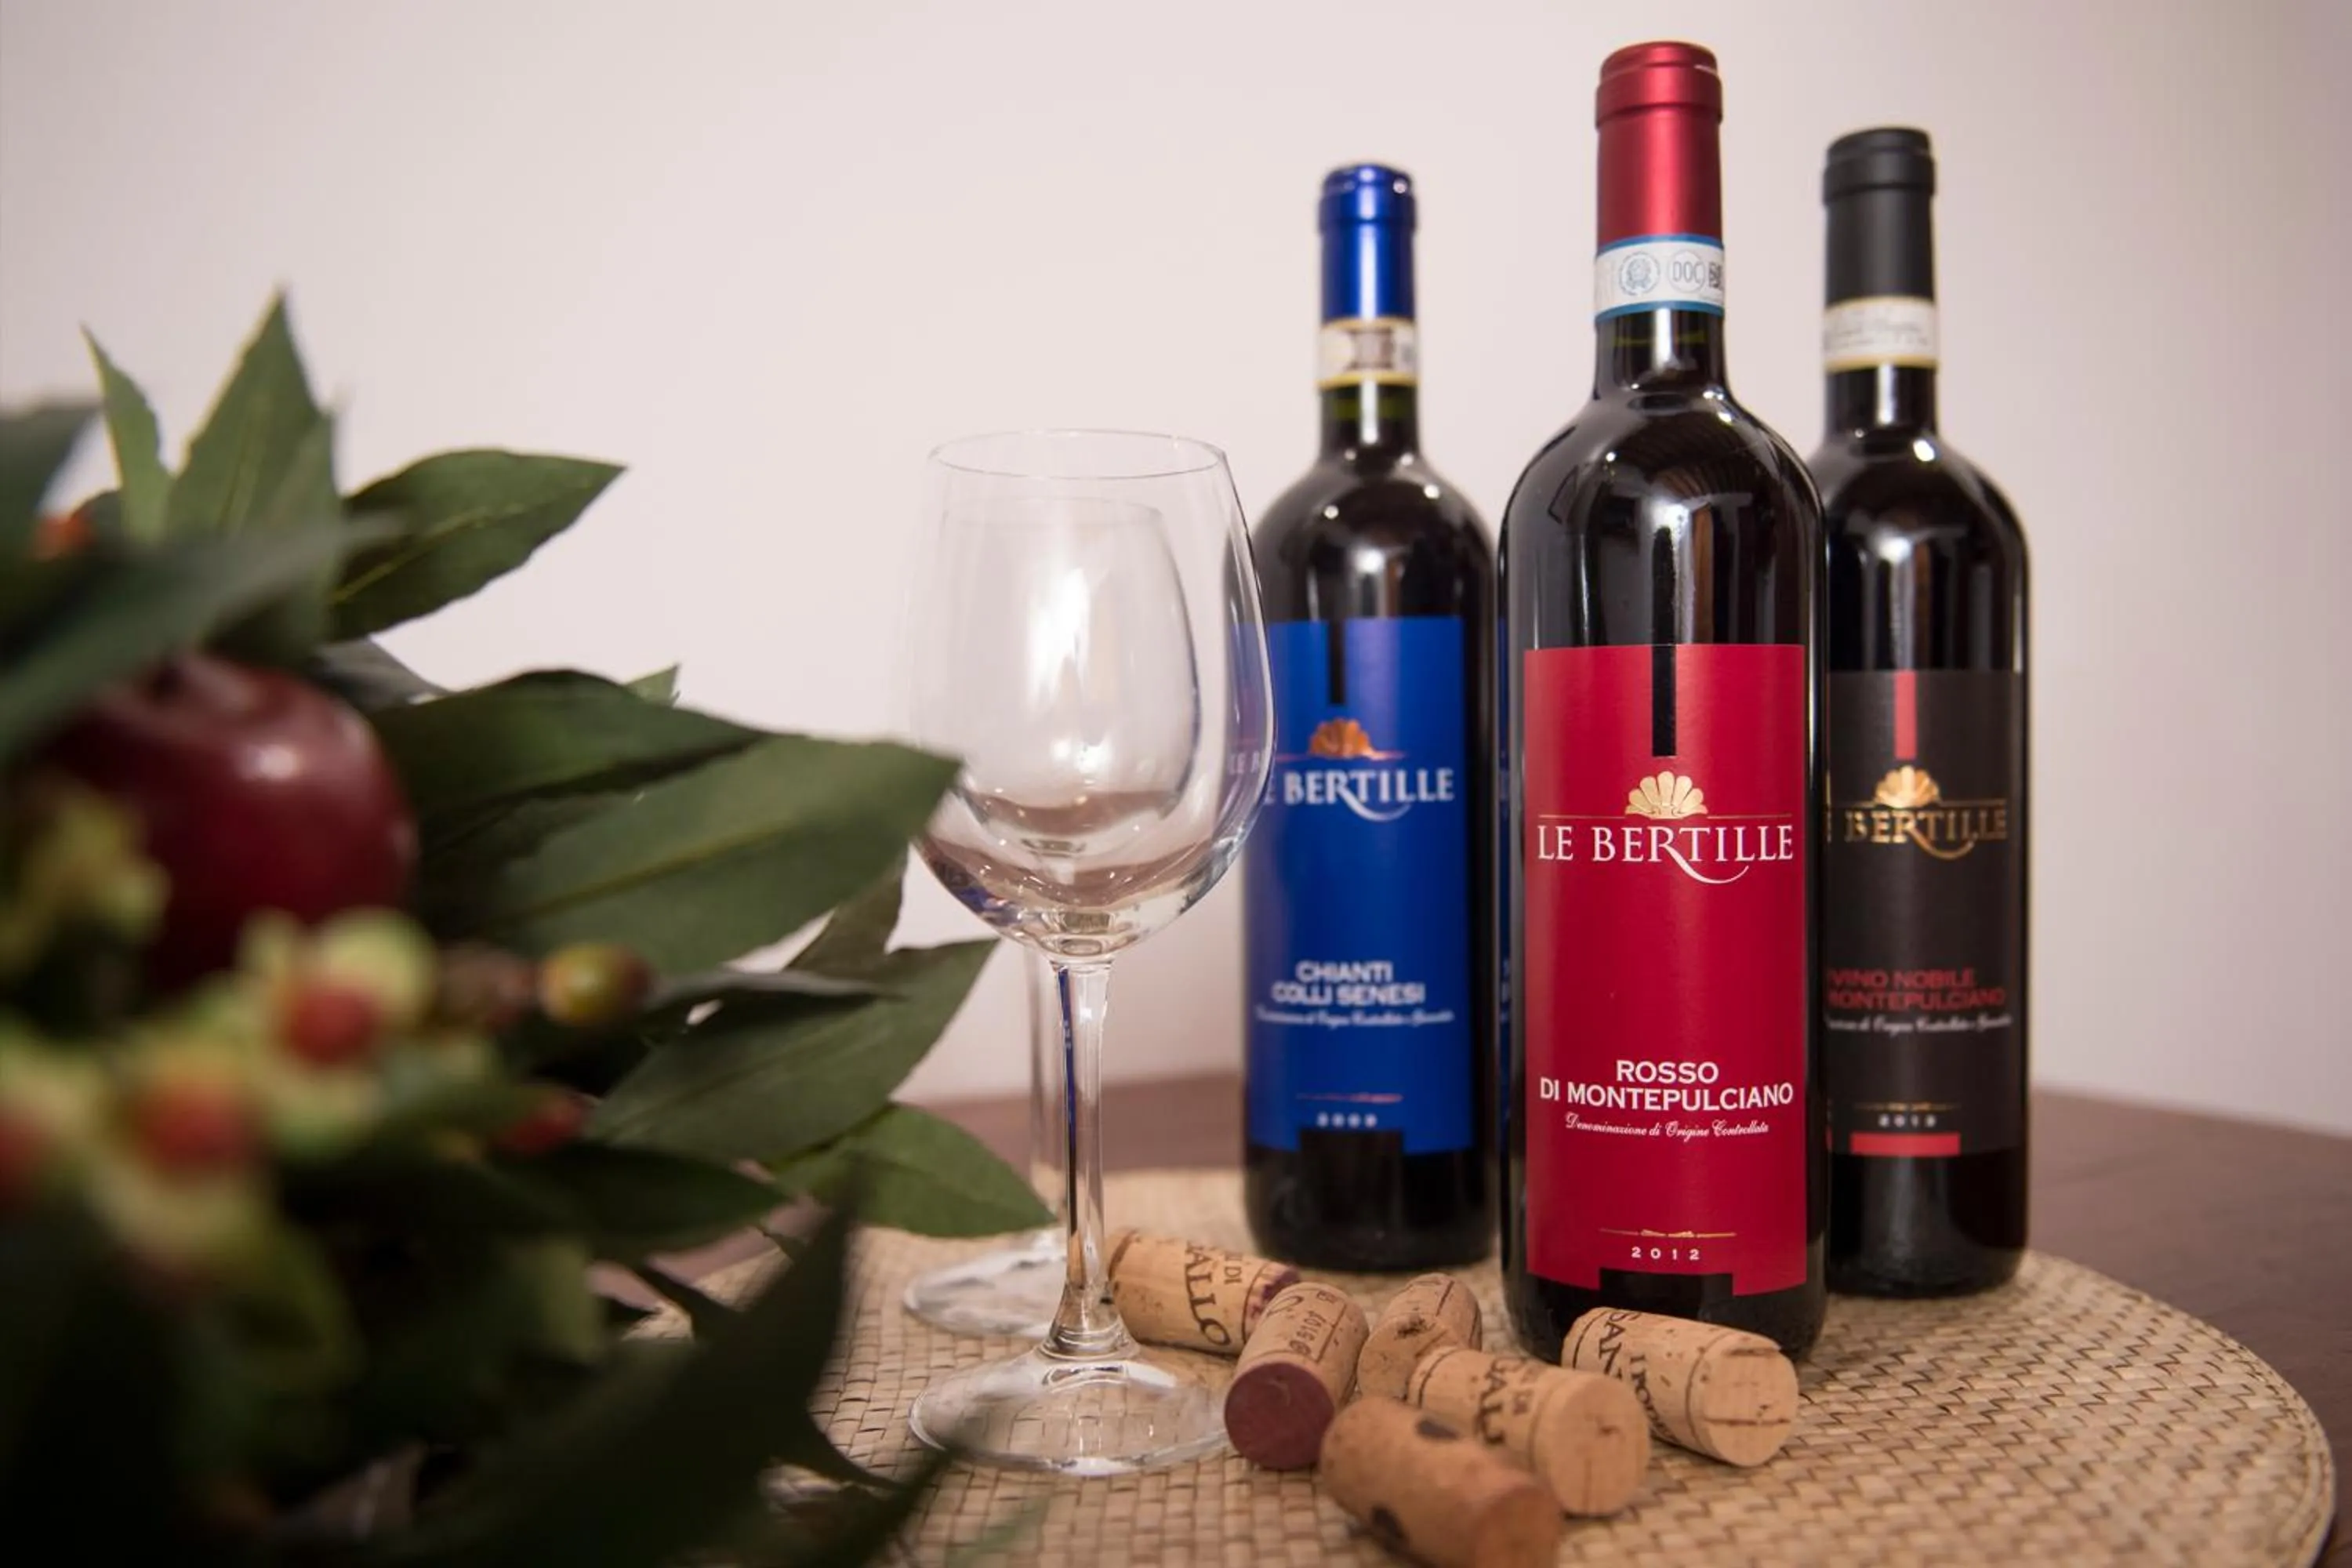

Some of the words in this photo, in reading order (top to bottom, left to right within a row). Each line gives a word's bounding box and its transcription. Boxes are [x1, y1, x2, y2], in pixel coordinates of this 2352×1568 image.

[1283, 768, 1454, 822] BERTILLE
[1843, 807, 2008, 859] BERTILLE
[1537, 825, 1574, 861] LE
[1591, 825, 1794, 884] BERTILLE
[1295, 960, 1394, 982] CHIANTI
[1830, 968, 1889, 989] VINO
[1892, 967, 1975, 989] NOBILE
[1271, 981, 1333, 1006] COLLI
[1336, 982, 1426, 1007] SENESI
[1616, 1059, 1719, 1084] ROSSO
[1539, 1076, 1560, 1102] DI
[1567, 1082, 1794, 1112] MONTEPULCIANO
[1565, 1111, 1647, 1136] Denominazione
[1649, 1122, 1661, 1137] di
[1664, 1120, 1710, 1142] Origine
[1711, 1119, 1769, 1138] Controllata
[1631, 1246, 1700, 1260] 2012
[1184, 1240, 1232, 1346] ALLO
